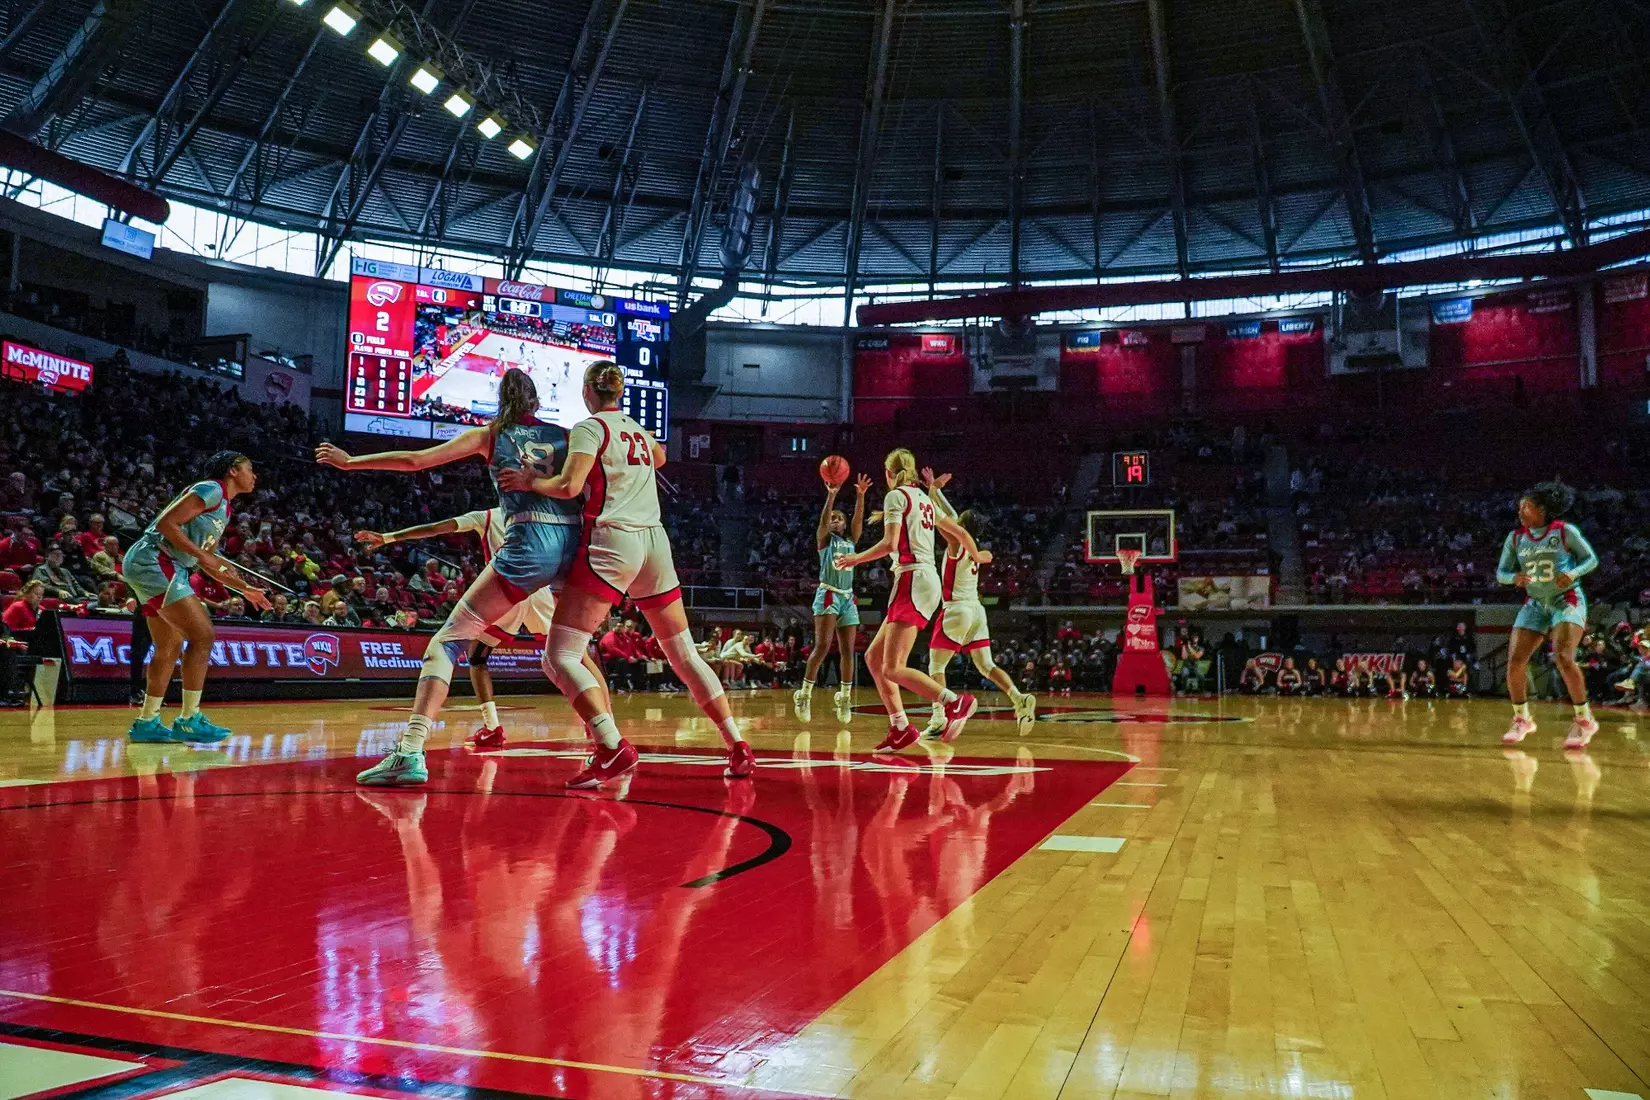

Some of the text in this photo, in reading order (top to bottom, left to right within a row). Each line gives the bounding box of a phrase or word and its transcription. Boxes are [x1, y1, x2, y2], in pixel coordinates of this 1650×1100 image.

[432, 270, 463, 284] LOGAN
[376, 311, 390, 332] 2
[7, 345, 90, 382] McMINUTE
[639, 347, 650, 365] 0
[514, 427, 542, 441] AIREY
[620, 431, 651, 465] 23
[1127, 465, 1143, 482] 19
[919, 501, 935, 531] 33
[1525, 559, 1554, 583] 23
[311, 640, 333, 653] WKU
[360, 641, 403, 656] FREE
[364, 656, 424, 669] Medium
